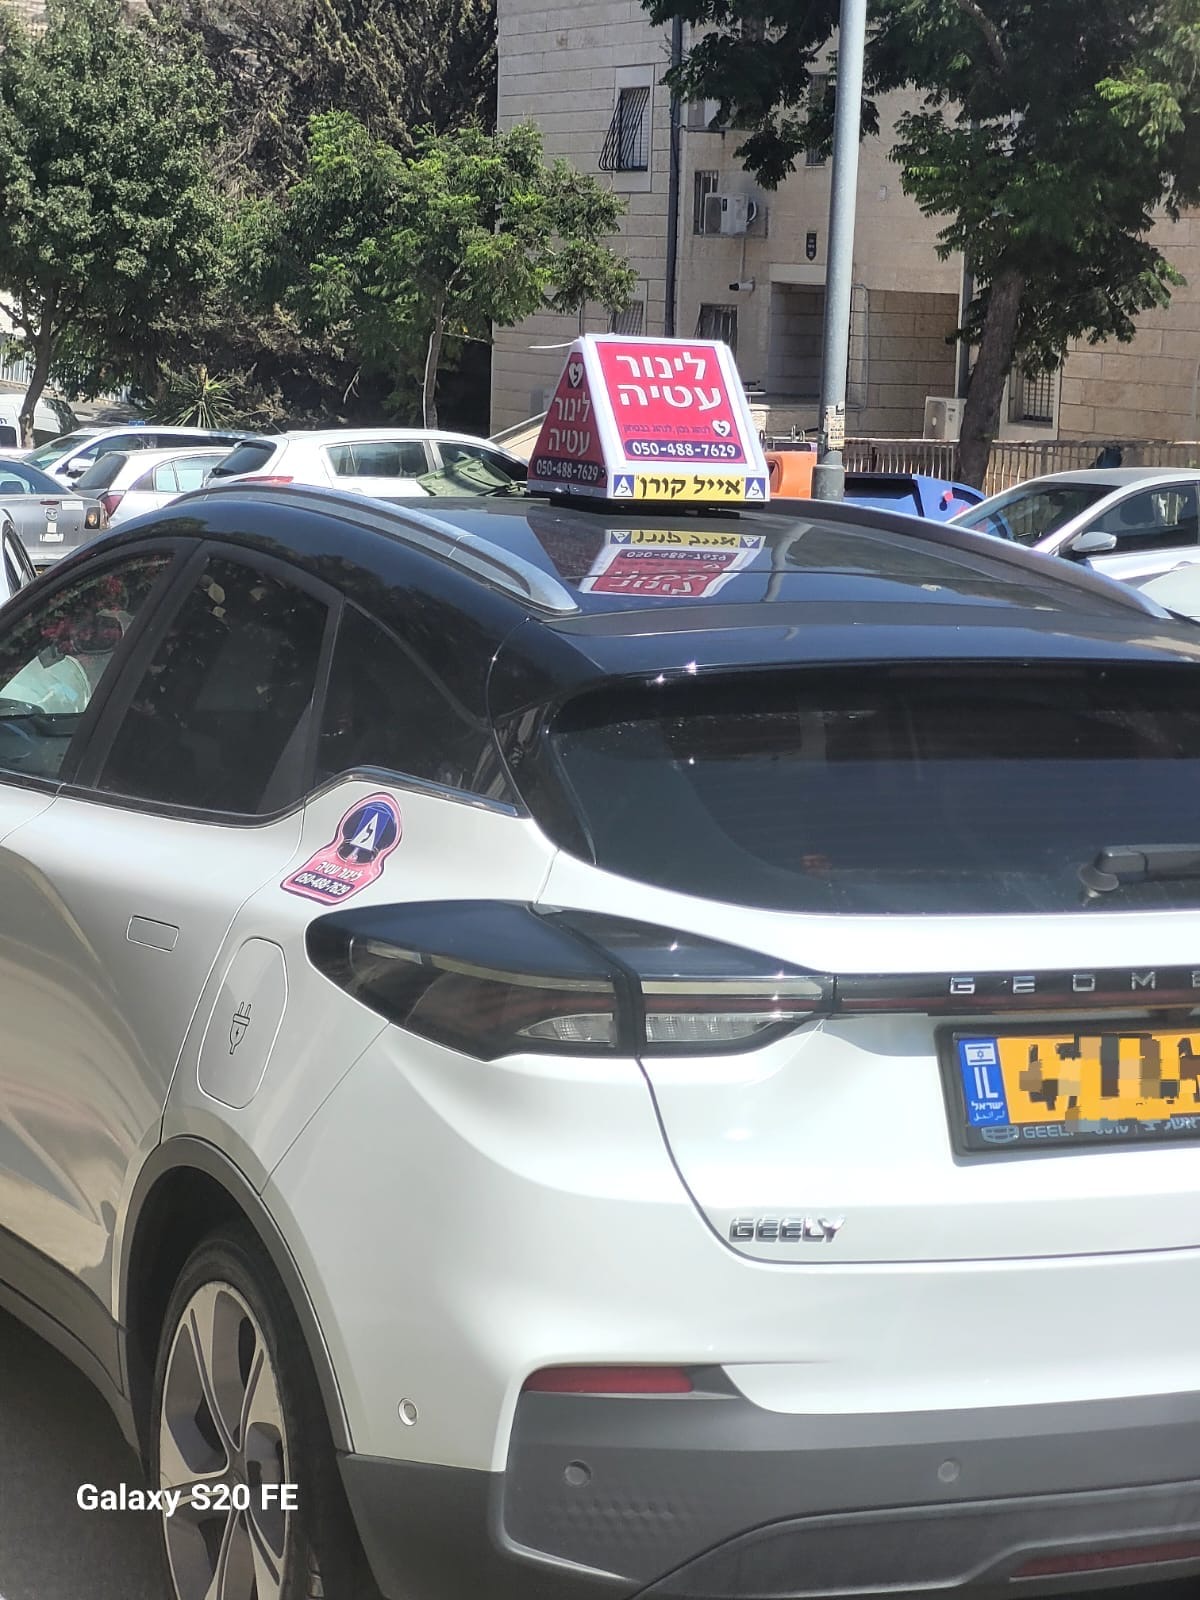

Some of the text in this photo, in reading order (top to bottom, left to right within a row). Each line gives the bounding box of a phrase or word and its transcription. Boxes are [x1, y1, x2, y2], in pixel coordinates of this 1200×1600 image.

[616, 351, 706, 380] לינור
[555, 392, 591, 422] לינור
[617, 384, 722, 411] עטיה
[548, 428, 590, 456] עטיה
[632, 441, 736, 457] 050-488-7629
[536, 459, 599, 480] 050-488-7629
[973, 1066, 999, 1099] IL
[971, 1100, 1004, 1111] ישראל
[1023, 1123, 1074, 1139] GEEL
[729, 1216, 845, 1243] GEELY
